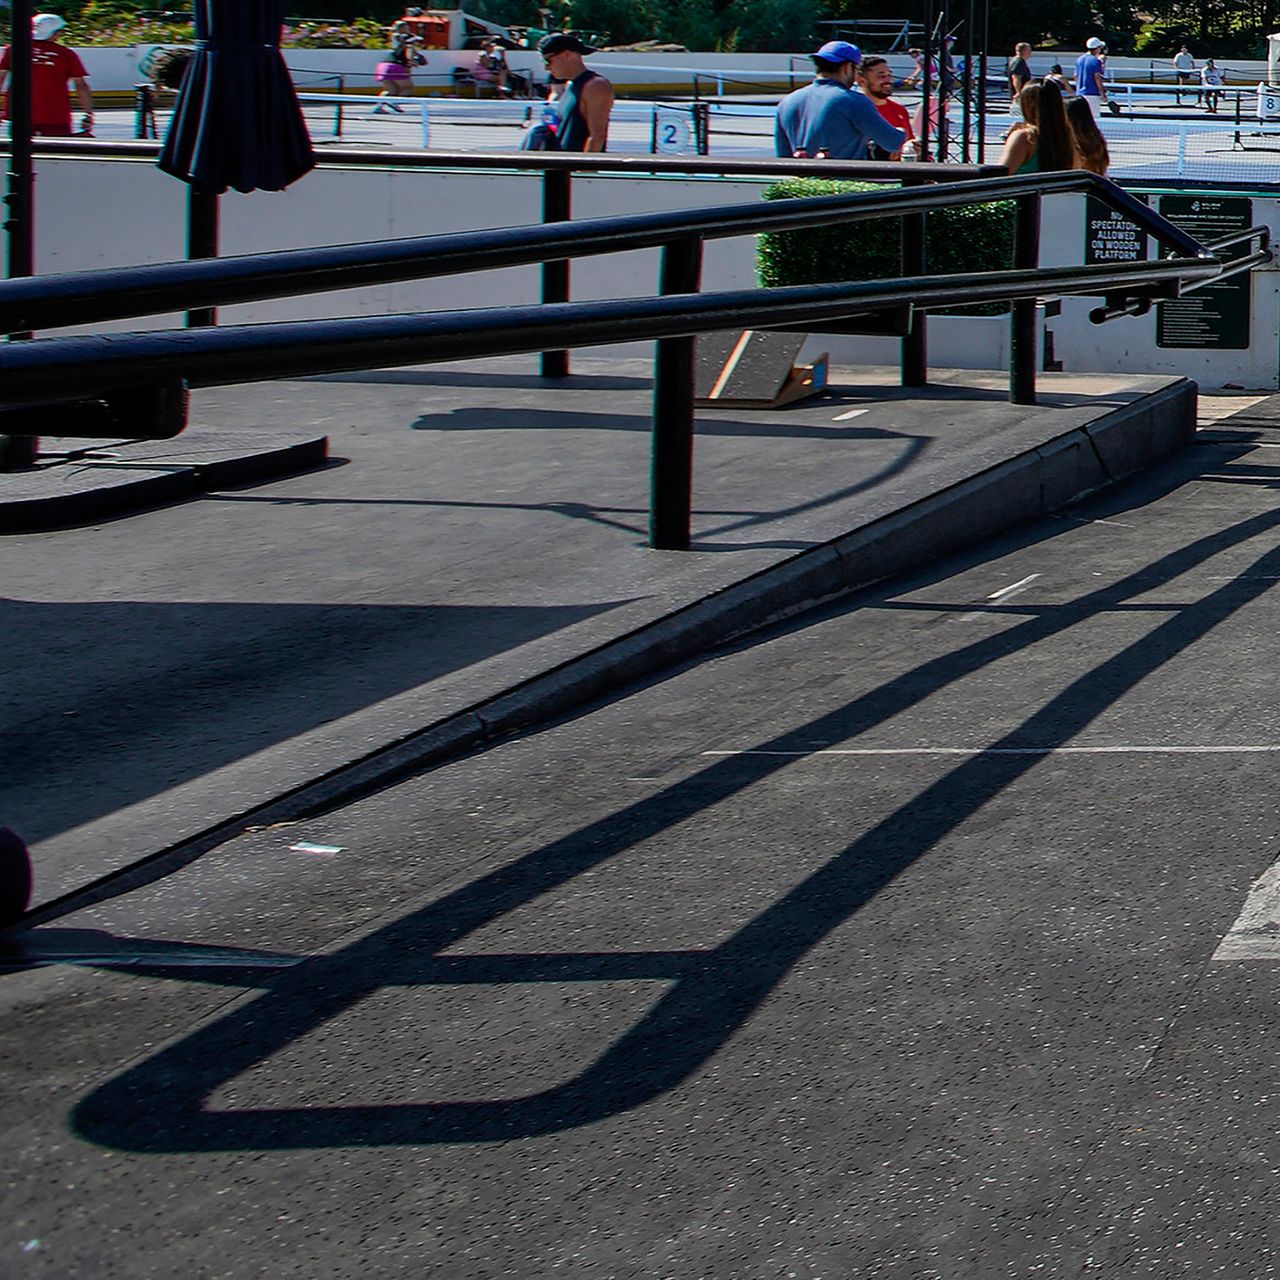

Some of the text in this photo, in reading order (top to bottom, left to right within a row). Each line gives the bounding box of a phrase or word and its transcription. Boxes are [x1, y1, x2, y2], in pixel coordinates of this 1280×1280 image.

[1267, 98, 1275, 109] 8
[663, 125, 677, 143] 2
[1091, 220, 1141, 231] SPECTATOR
[1097, 231, 1136, 241] ALLOWED
[1091, 240, 1140, 251] ON WOODEN
[1094, 250, 1137, 260] PLATFORM
